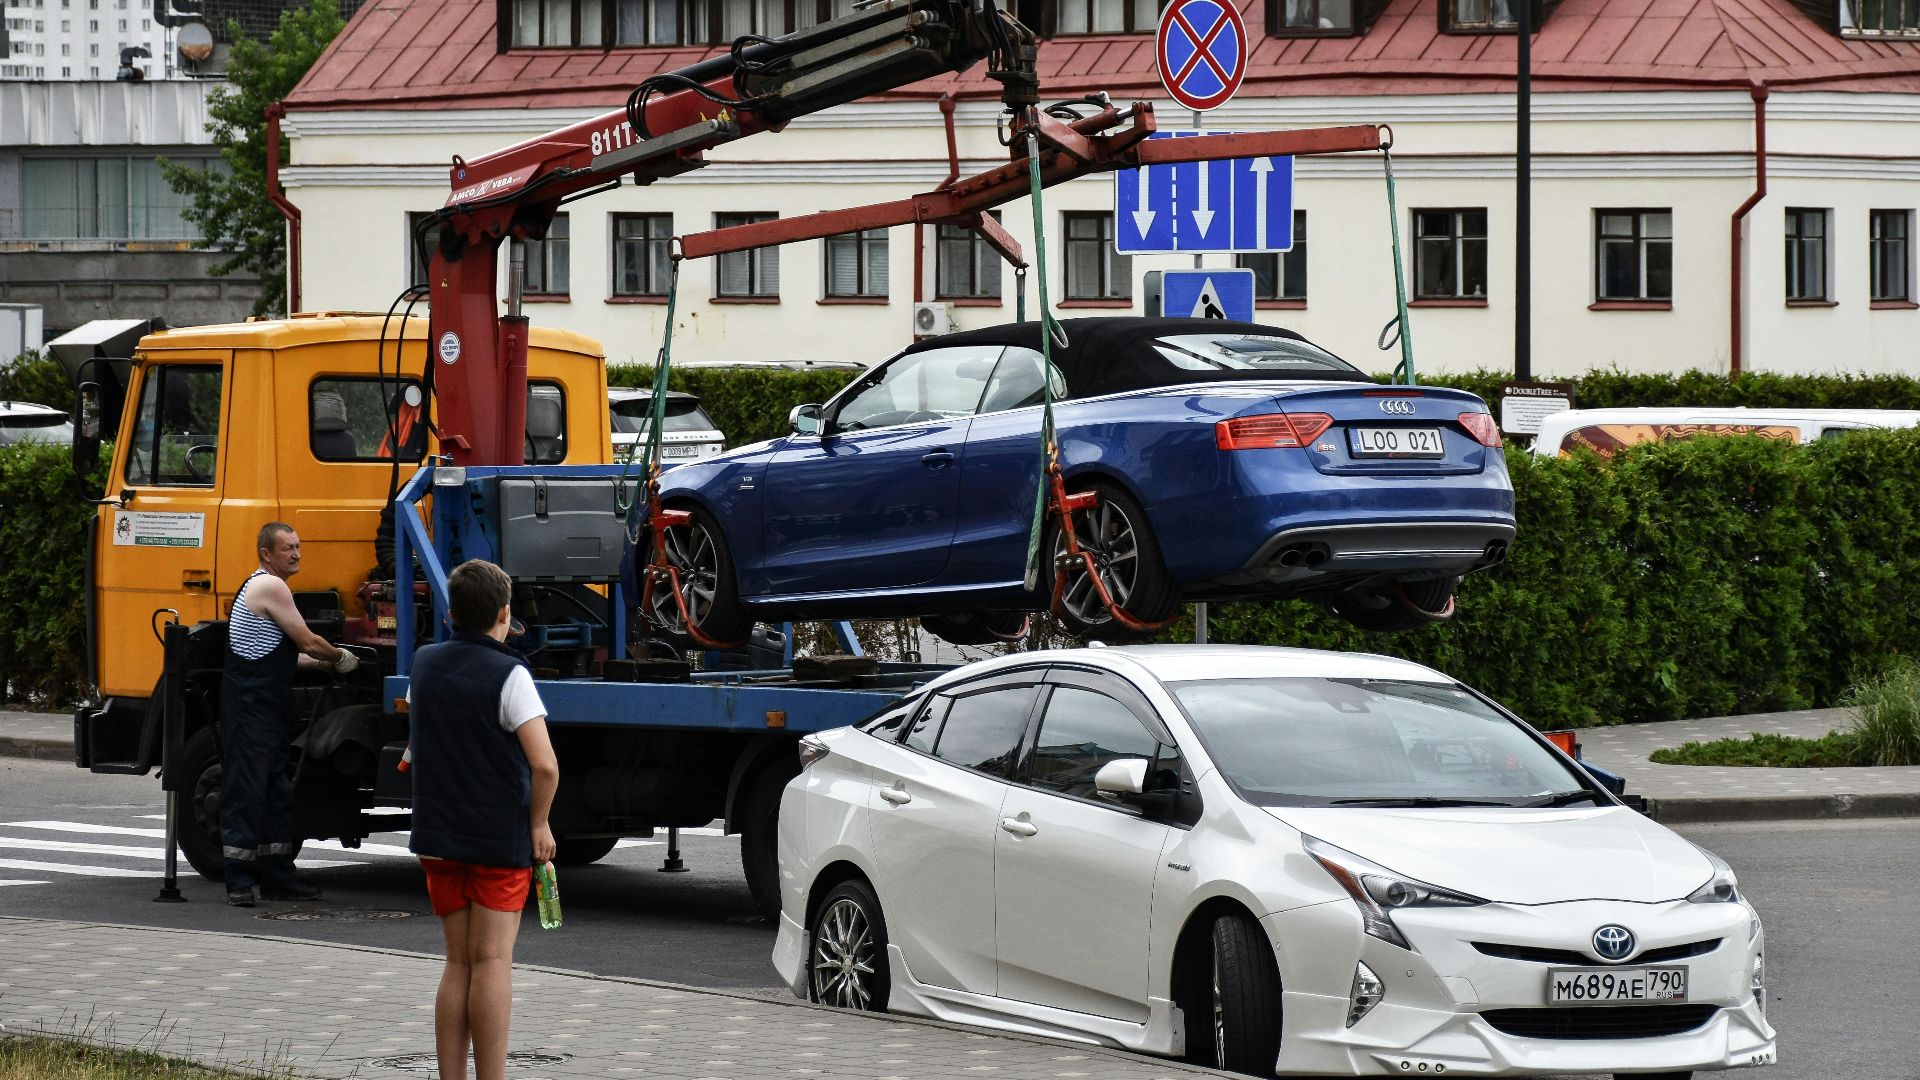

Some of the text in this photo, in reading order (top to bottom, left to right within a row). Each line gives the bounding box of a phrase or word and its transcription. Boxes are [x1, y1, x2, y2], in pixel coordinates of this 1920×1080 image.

[591, 121, 631, 155] 811T
[451, 188, 475, 202] AMCO
[492, 177, 513, 188] VEBA
[1360, 430, 1439, 451] LOO 021
[1648, 971, 1682, 991] 790
[1656, 991, 1673, 999] RUS
